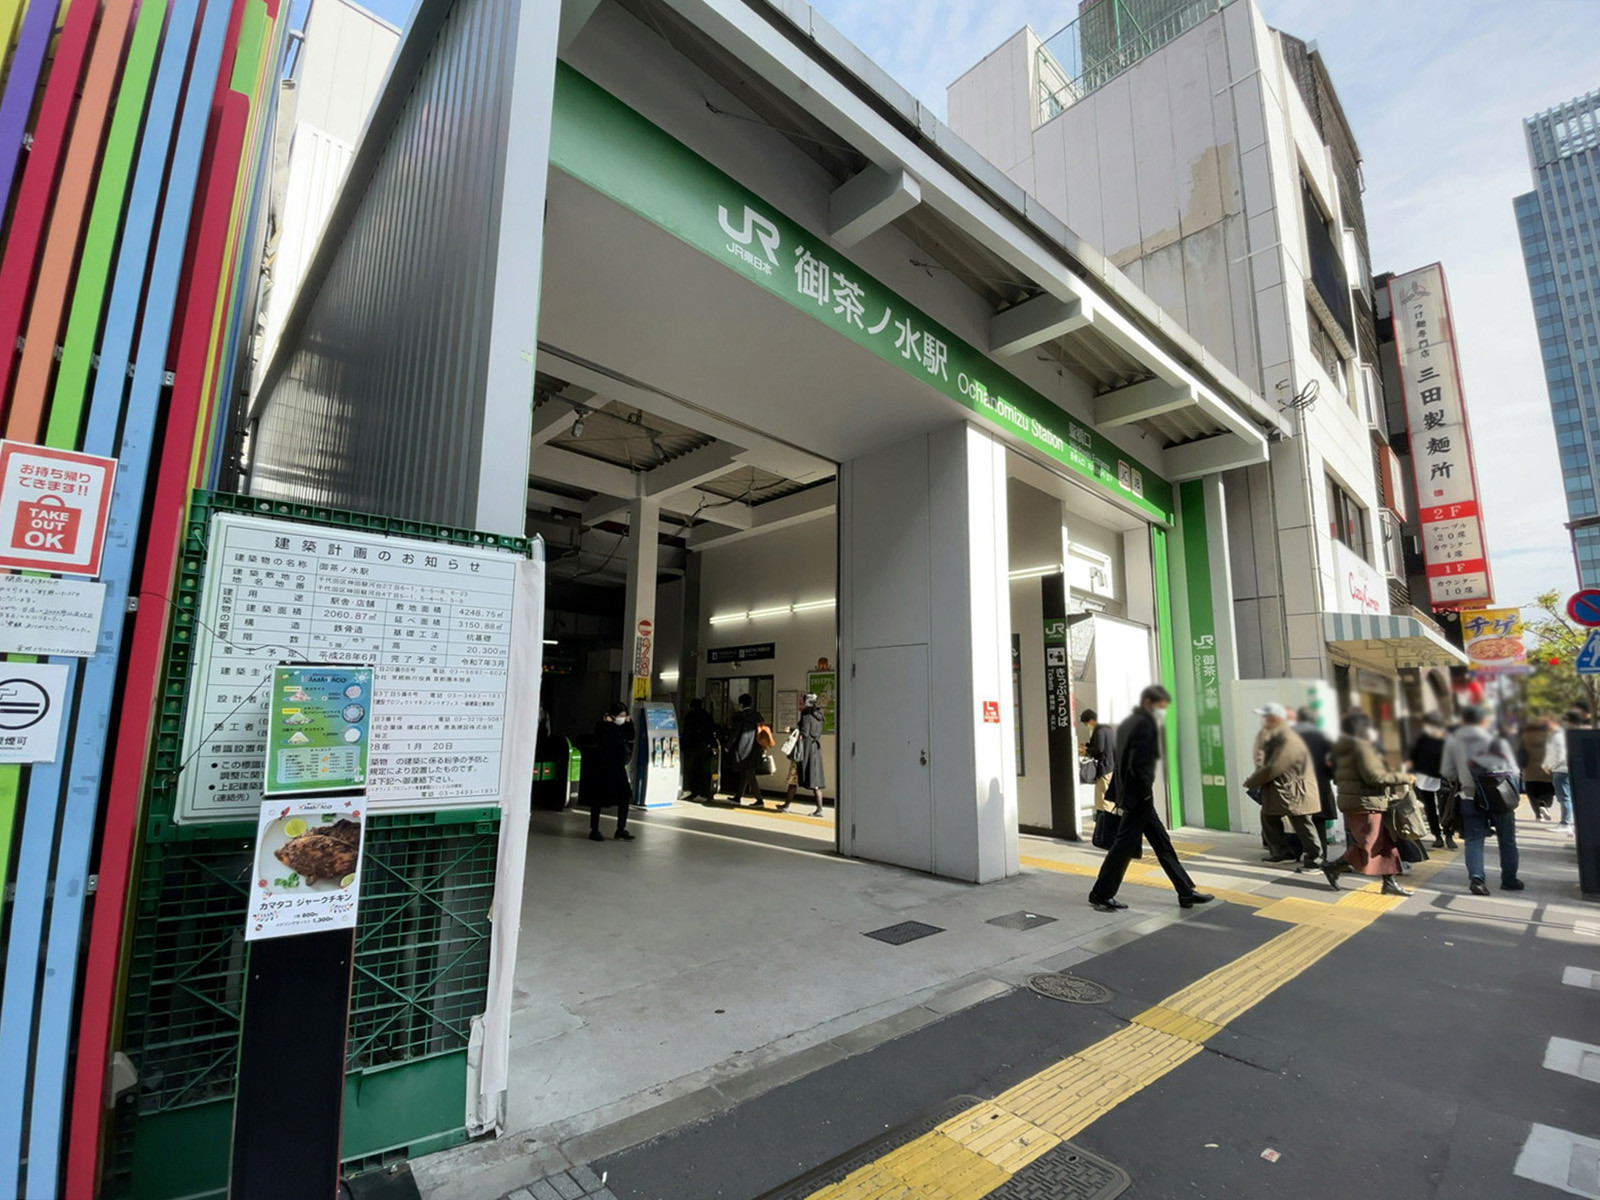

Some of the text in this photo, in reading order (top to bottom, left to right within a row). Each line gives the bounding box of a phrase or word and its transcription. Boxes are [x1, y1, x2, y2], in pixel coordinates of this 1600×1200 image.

[718, 204, 780, 267] JR
[726, 242, 773, 276] JR東日本
[793, 245, 948, 382] 御茶ノ水駅
[1417, 366, 1454, 481] 三田製麺所
[1031, 418, 1064, 452] Station
[20, 463, 92, 484] お持ち帰り
[18, 476, 89, 496] できます!!
[29, 507, 71, 522] TAKE
[1433, 505, 1462, 520] 2F
[31, 518, 66, 531] OUT
[24, 530, 65, 549] OK
[274, 536, 481, 573] 建築計画のお知らせ
[319, 562, 370, 576] 御茶ノ水駅
[1444, 562, 1466, 574] 1F
[1464, 614, 1520, 636] チゲ
[1193, 634, 1214, 647] JR
[260, 894, 352, 911] カマタコ ジャークチキン
